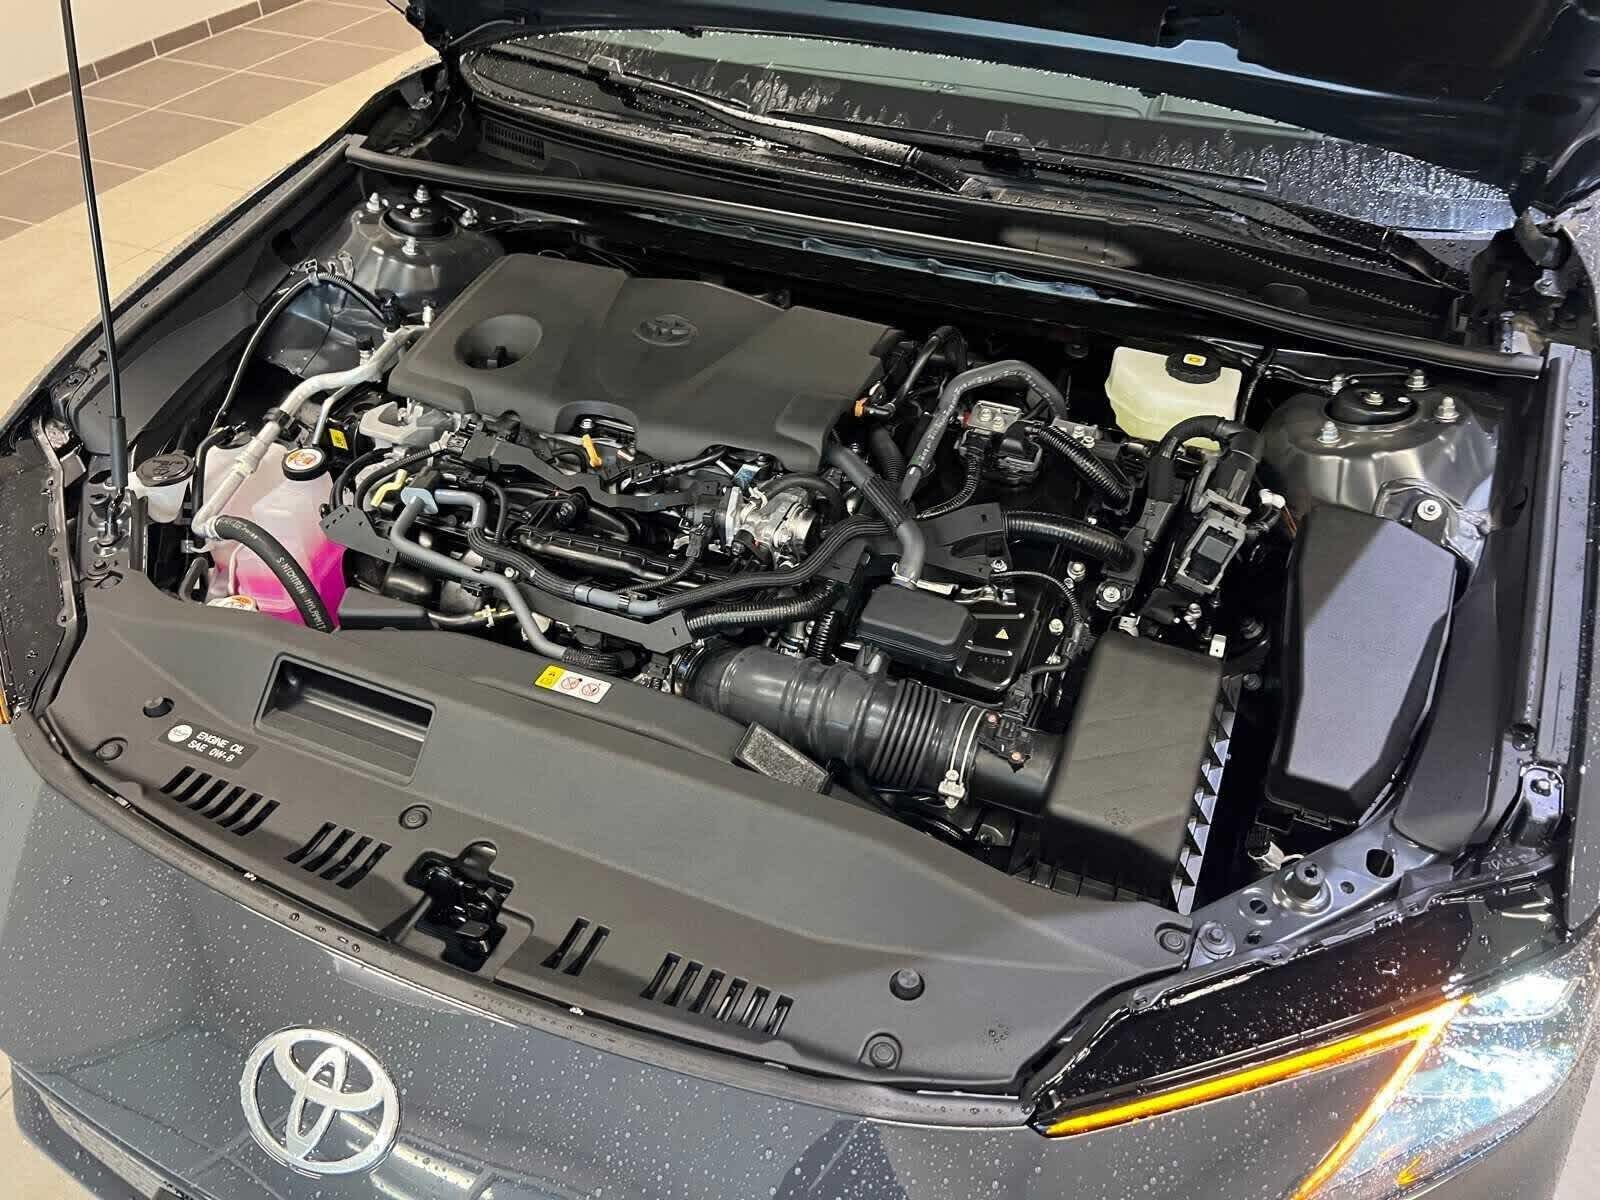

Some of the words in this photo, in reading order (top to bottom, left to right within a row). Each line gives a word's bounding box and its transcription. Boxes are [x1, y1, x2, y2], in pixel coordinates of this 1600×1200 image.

[187, 740, 209, 753] SAE
[196, 731, 229, 748] ENGINE
[229, 743, 244, 755] OIL
